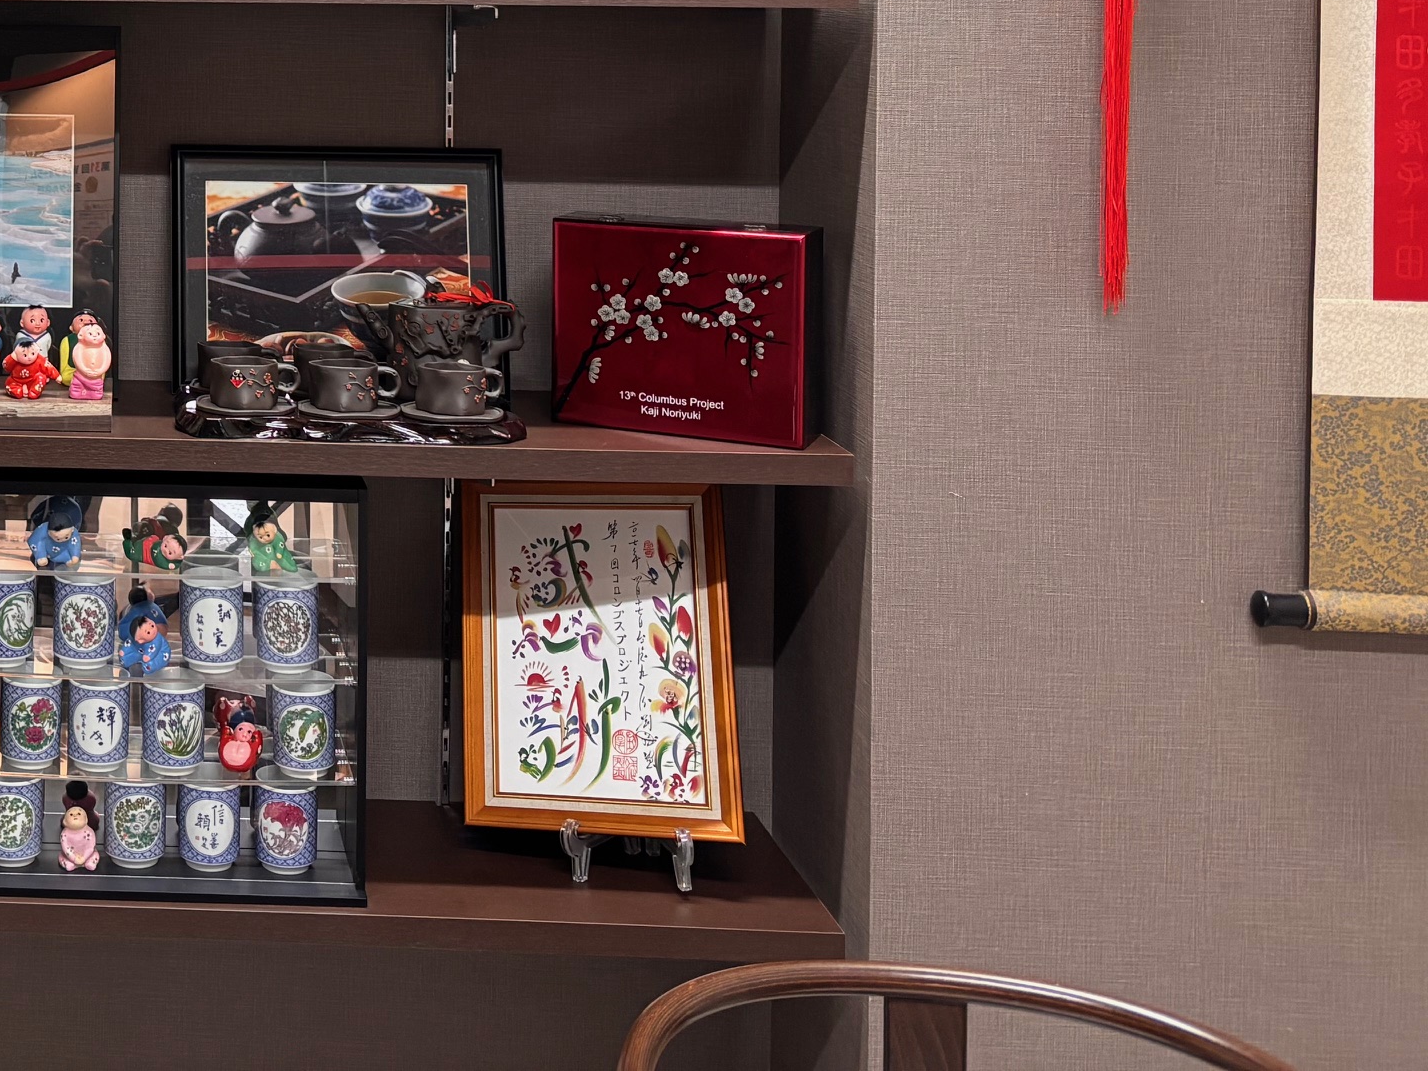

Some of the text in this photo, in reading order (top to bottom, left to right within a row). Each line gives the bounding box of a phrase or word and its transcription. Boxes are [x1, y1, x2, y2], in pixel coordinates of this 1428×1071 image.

[619, 390, 725, 411] 13th Columbus Project
[641, 405, 701, 421] Kaji Noriyuki
